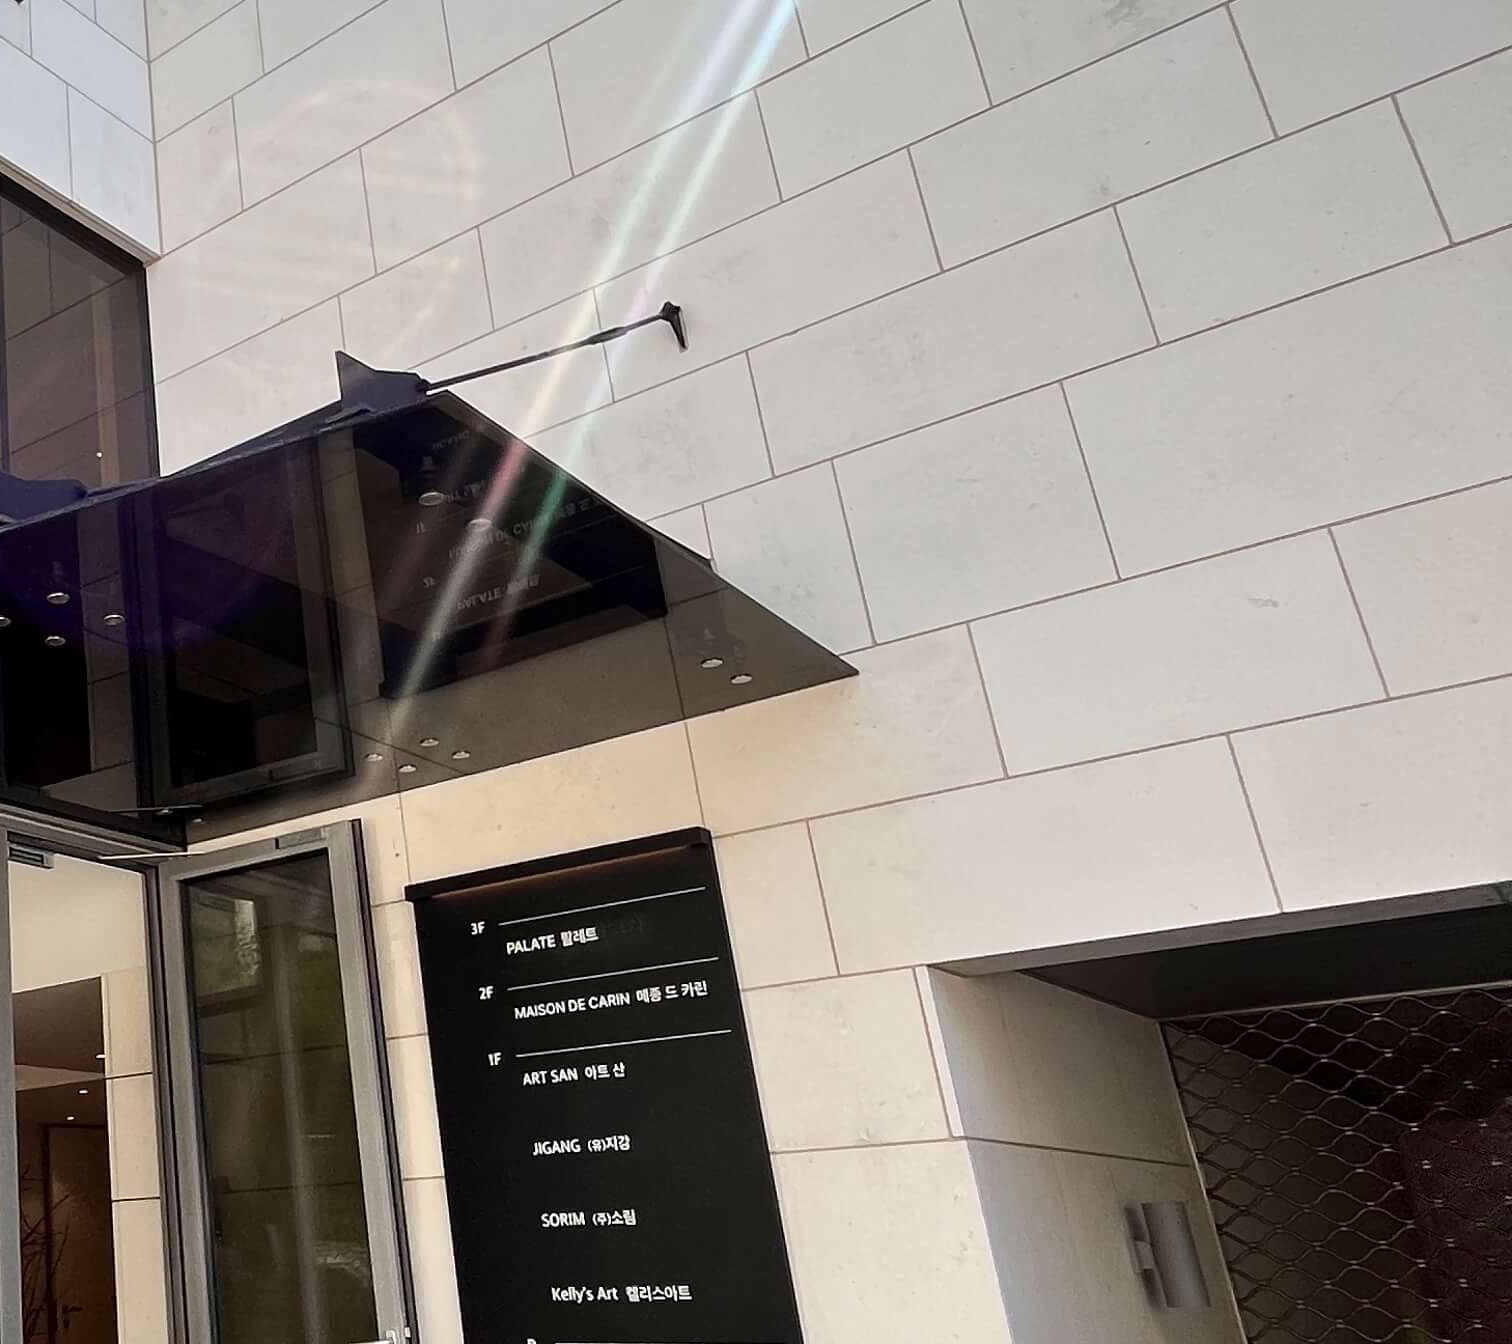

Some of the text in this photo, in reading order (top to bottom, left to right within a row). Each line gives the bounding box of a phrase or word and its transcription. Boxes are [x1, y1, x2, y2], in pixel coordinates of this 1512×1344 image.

[470, 921, 485, 936] 3F
[506, 926, 599, 955] PALATE 팔레트
[478, 985, 494, 1001] 2F
[514, 979, 709, 1020] MAISON DE CARIN 메종 드 카린
[487, 1052, 502, 1067] 1F
[522, 1061, 626, 1086] ART SAN 아트 산
[532, 1134, 631, 1156] JIGANG (유)지강
[540, 1208, 637, 1228] SORIM (주)소림
[551, 1284, 693, 1304] Kelly's Art 켈리스아트
